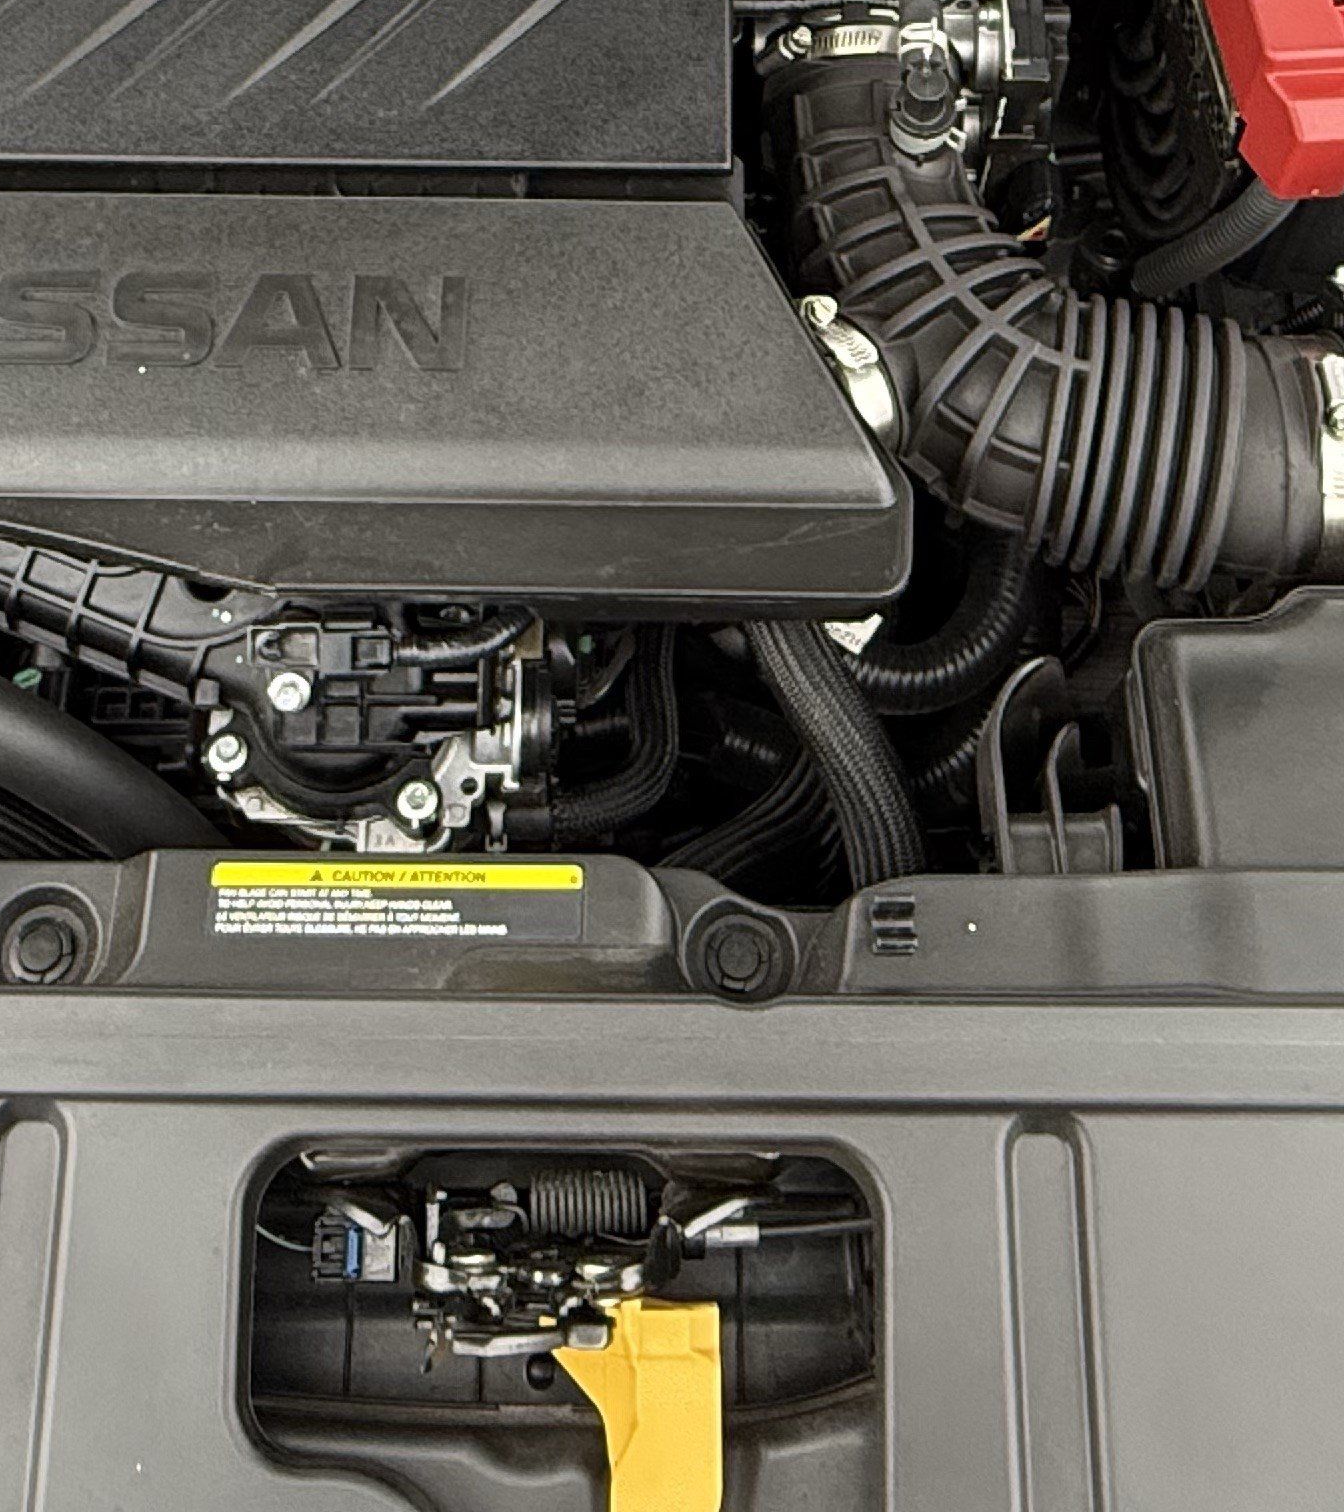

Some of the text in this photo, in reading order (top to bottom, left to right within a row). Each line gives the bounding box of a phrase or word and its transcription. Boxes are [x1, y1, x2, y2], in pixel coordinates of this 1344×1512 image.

[331, 869, 487, 884] CAUTION / ATTENTION
